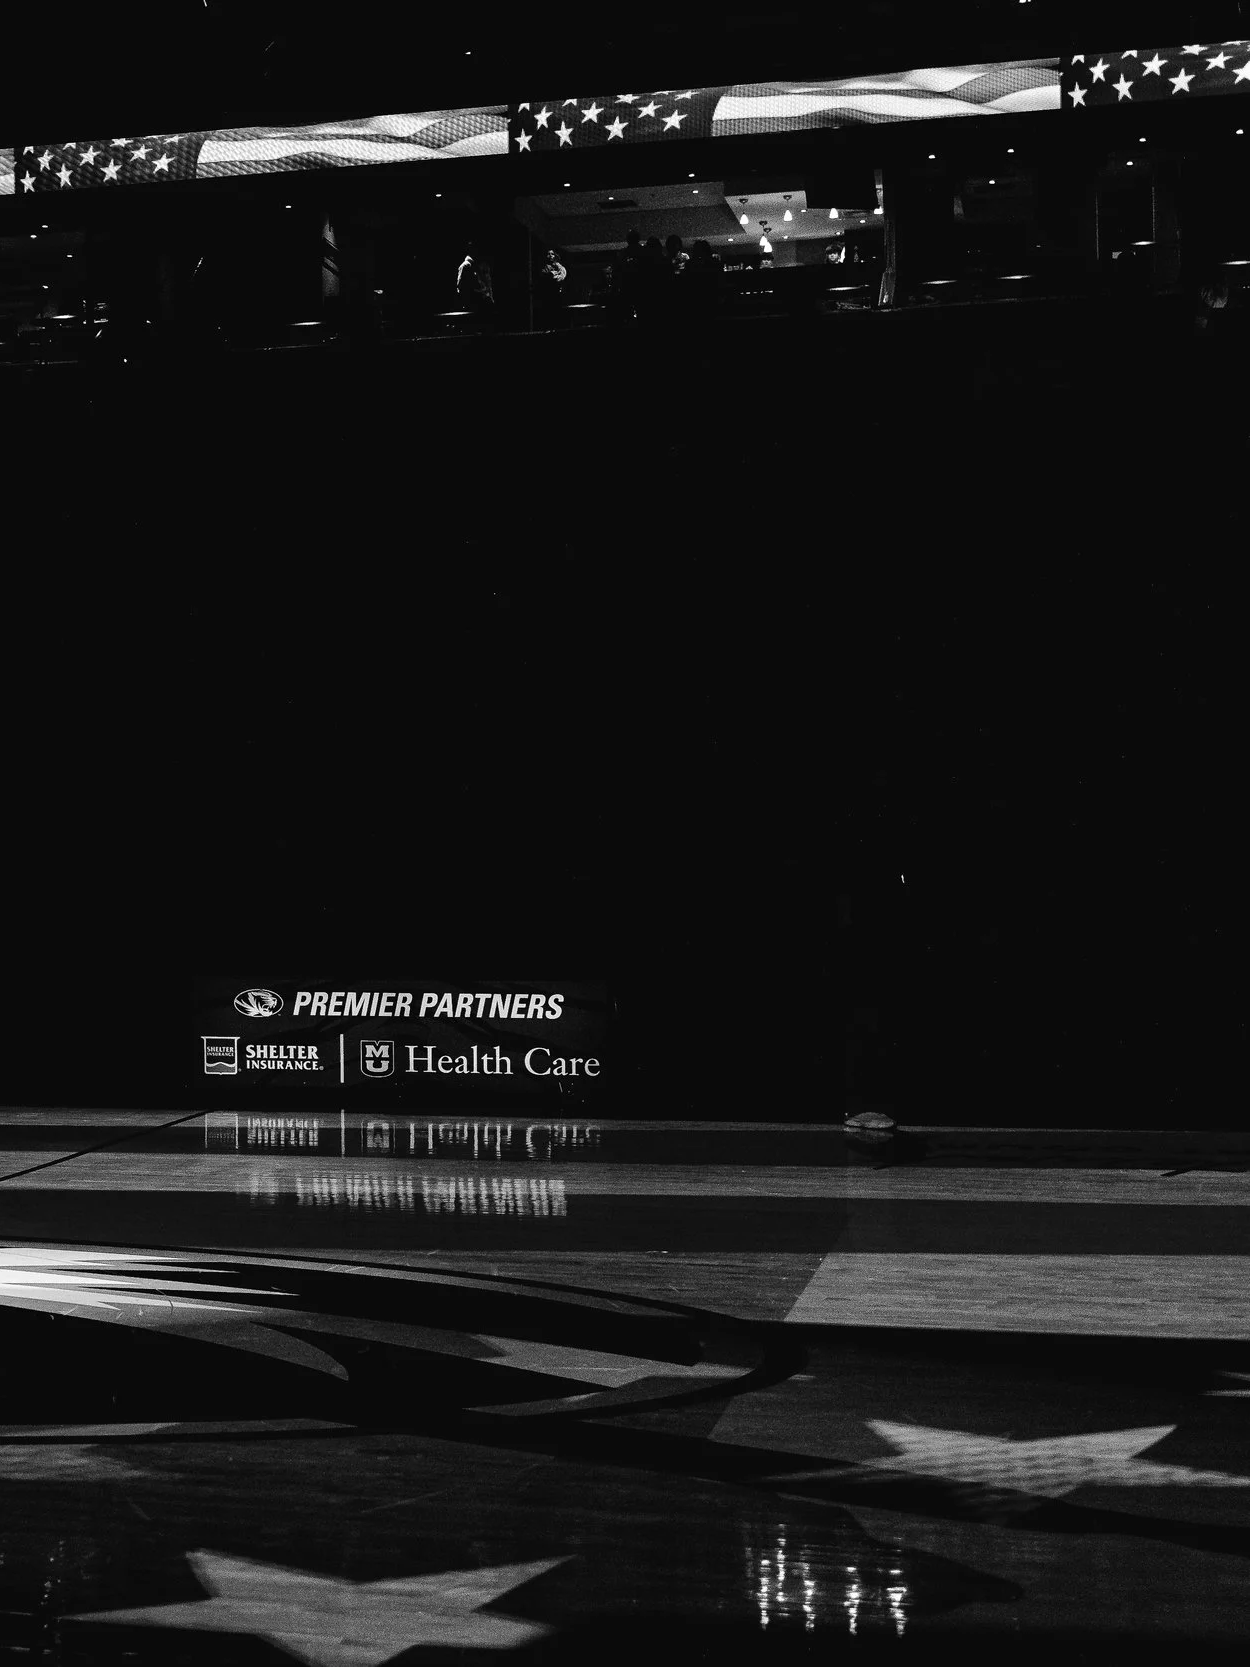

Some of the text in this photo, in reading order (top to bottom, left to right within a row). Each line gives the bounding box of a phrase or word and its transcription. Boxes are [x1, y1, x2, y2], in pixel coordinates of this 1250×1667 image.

[292, 992, 565, 1019] PREMIER PARTNERS
[246, 1044, 319, 1059] SHELTER
[405, 1044, 601, 1076] Health Care
